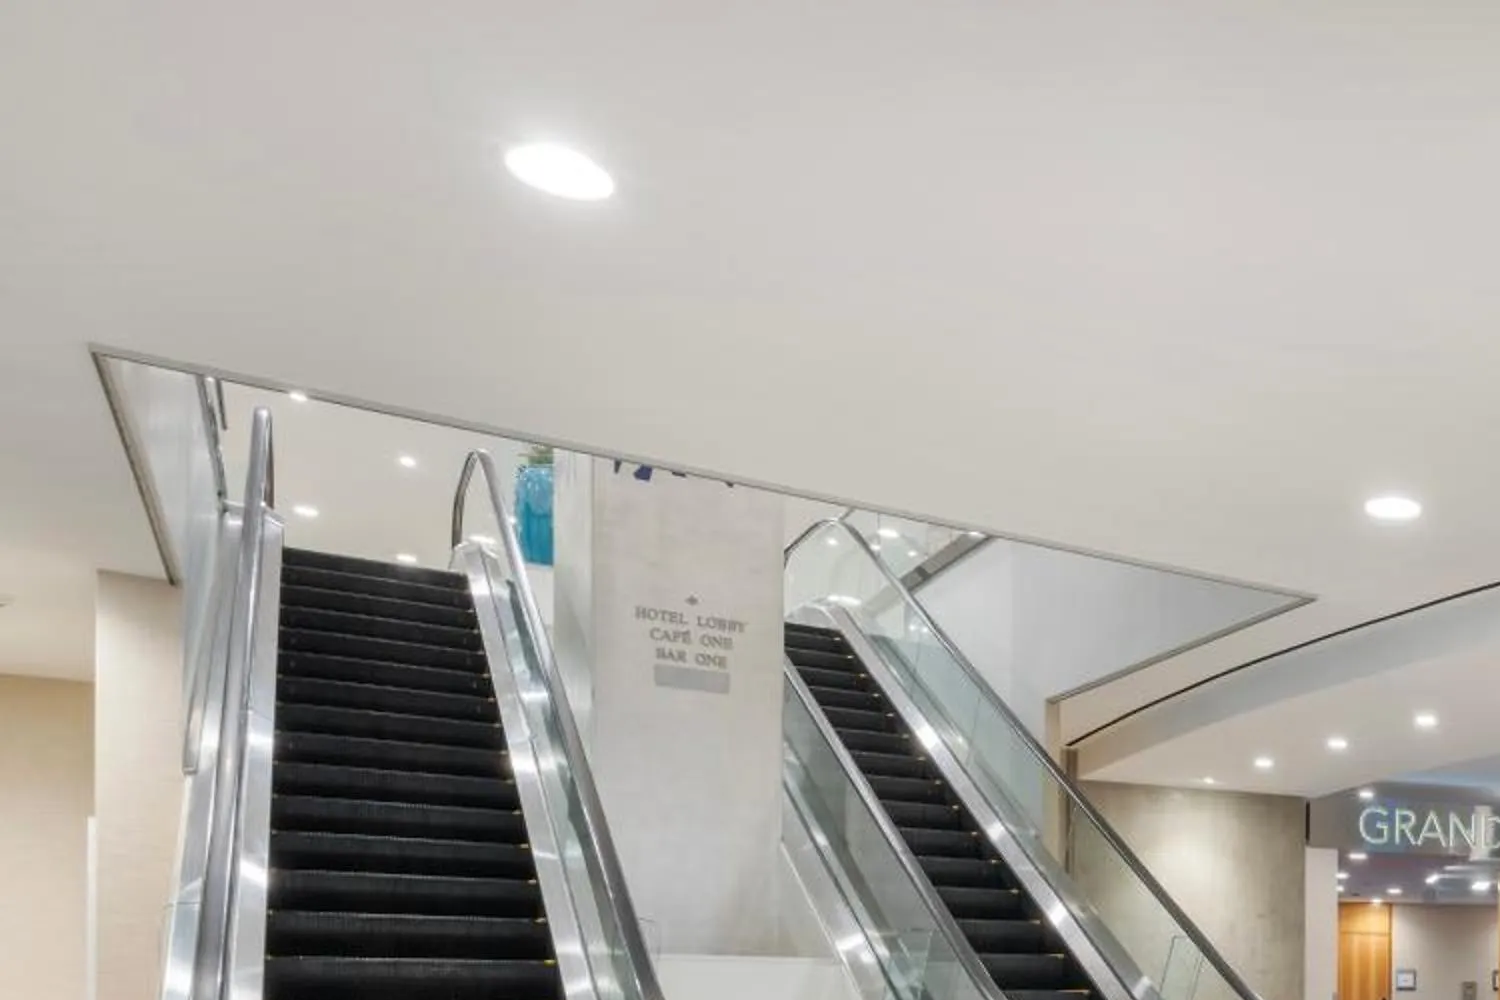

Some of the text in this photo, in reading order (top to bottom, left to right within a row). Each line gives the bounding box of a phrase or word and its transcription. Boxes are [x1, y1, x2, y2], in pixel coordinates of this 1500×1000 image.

[635, 605, 749, 633] HOTEL LOBBY
[700, 633, 734, 651] ONE
[655, 647, 728, 670] BAR ONE
